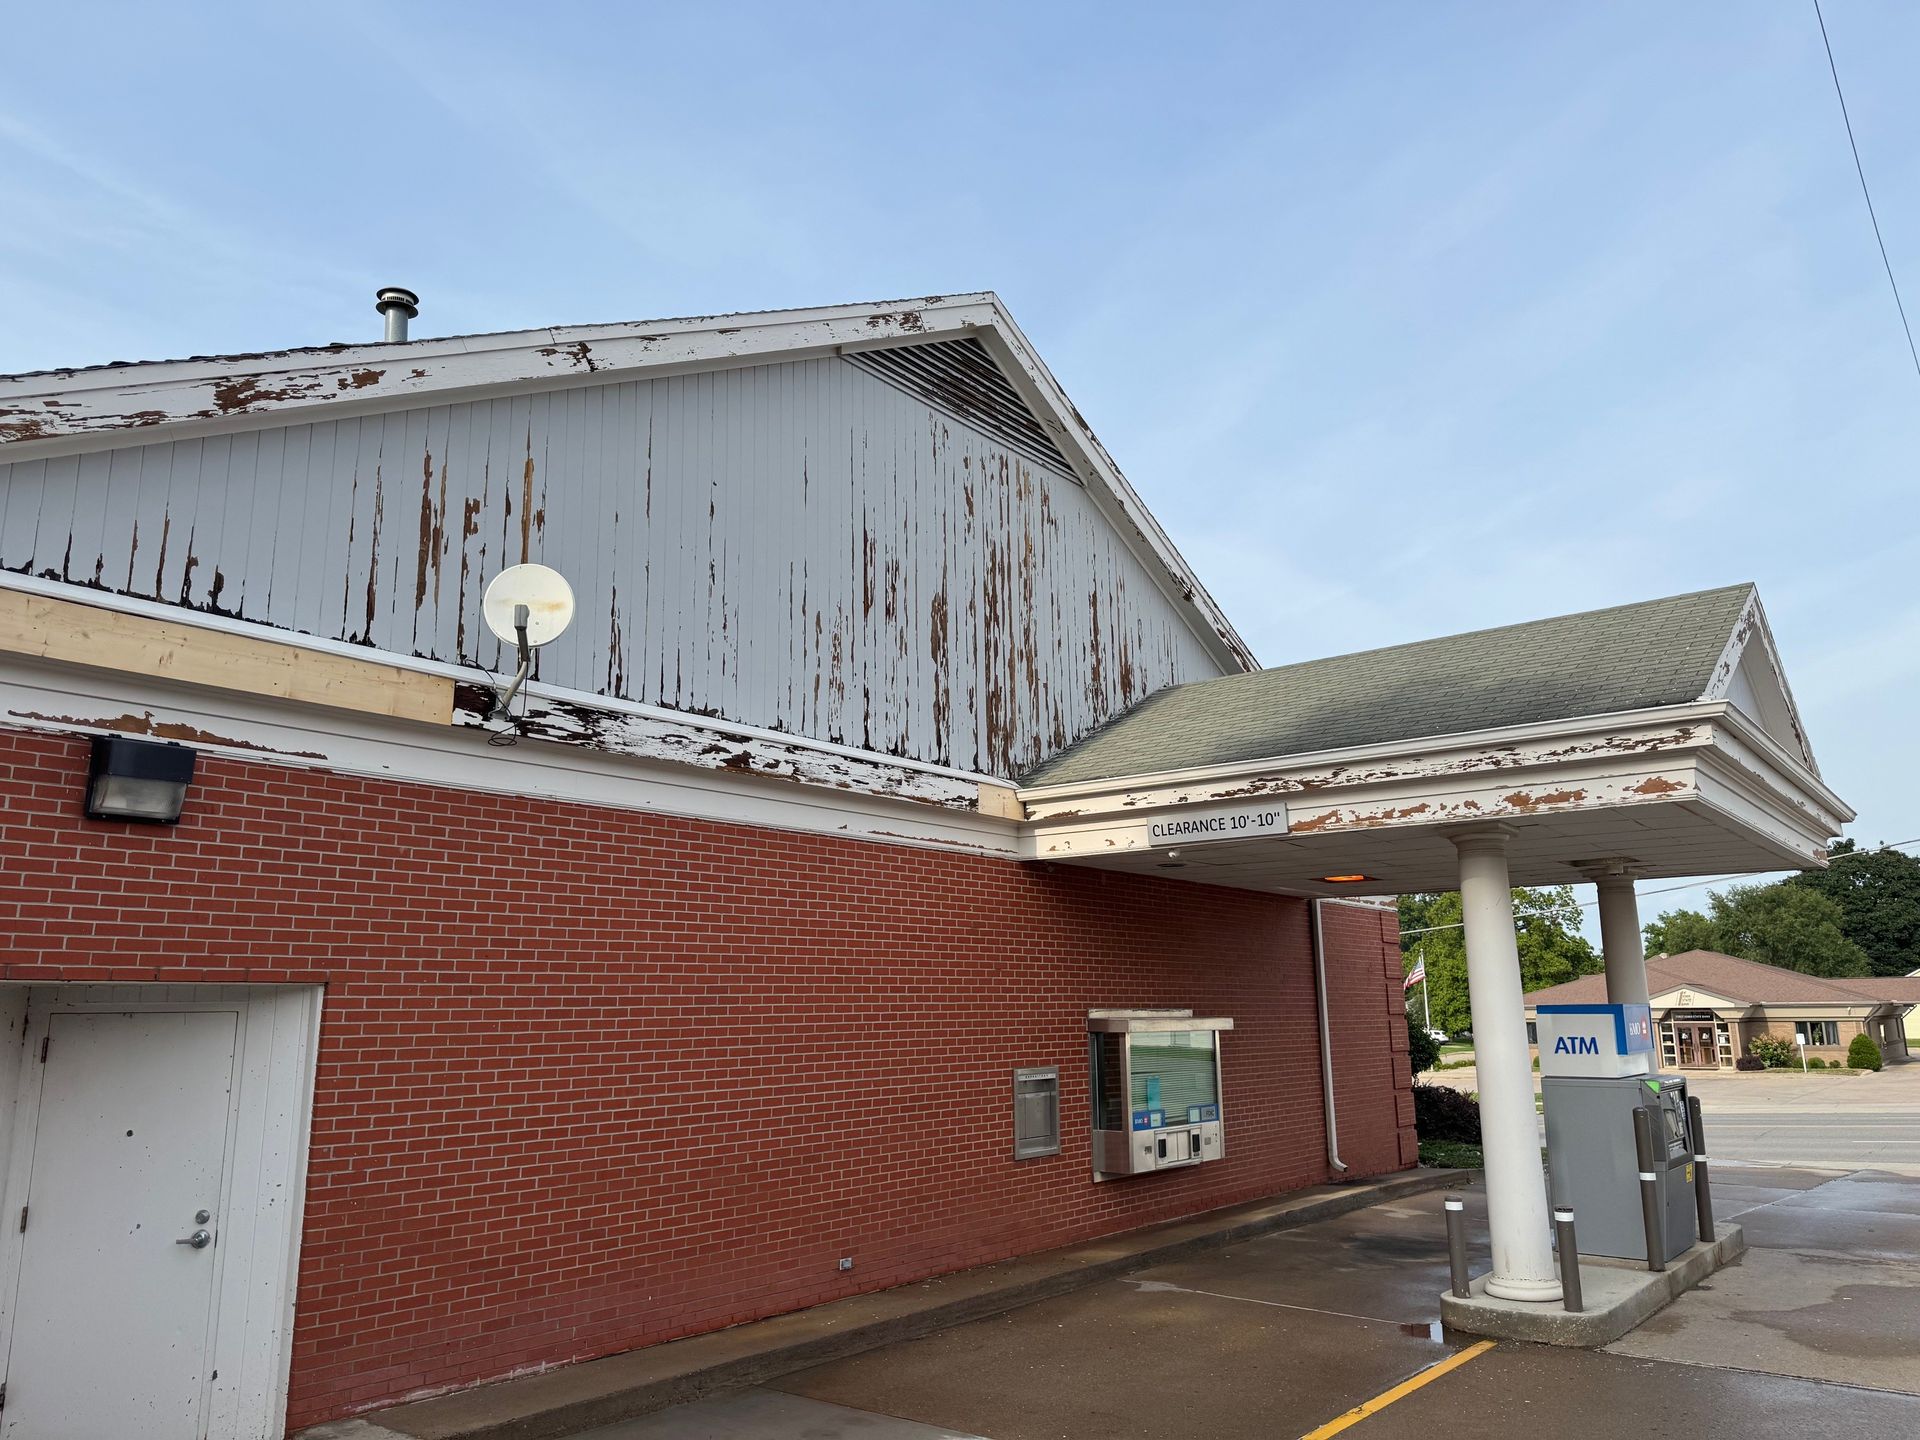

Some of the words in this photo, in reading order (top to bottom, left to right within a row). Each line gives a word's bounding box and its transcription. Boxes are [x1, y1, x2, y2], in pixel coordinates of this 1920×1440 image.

[1152, 817, 1226, 837] CLEARANCE
[1230, 811, 1280, 830] 10'-10"
[1554, 1036, 1599, 1055] ATM
